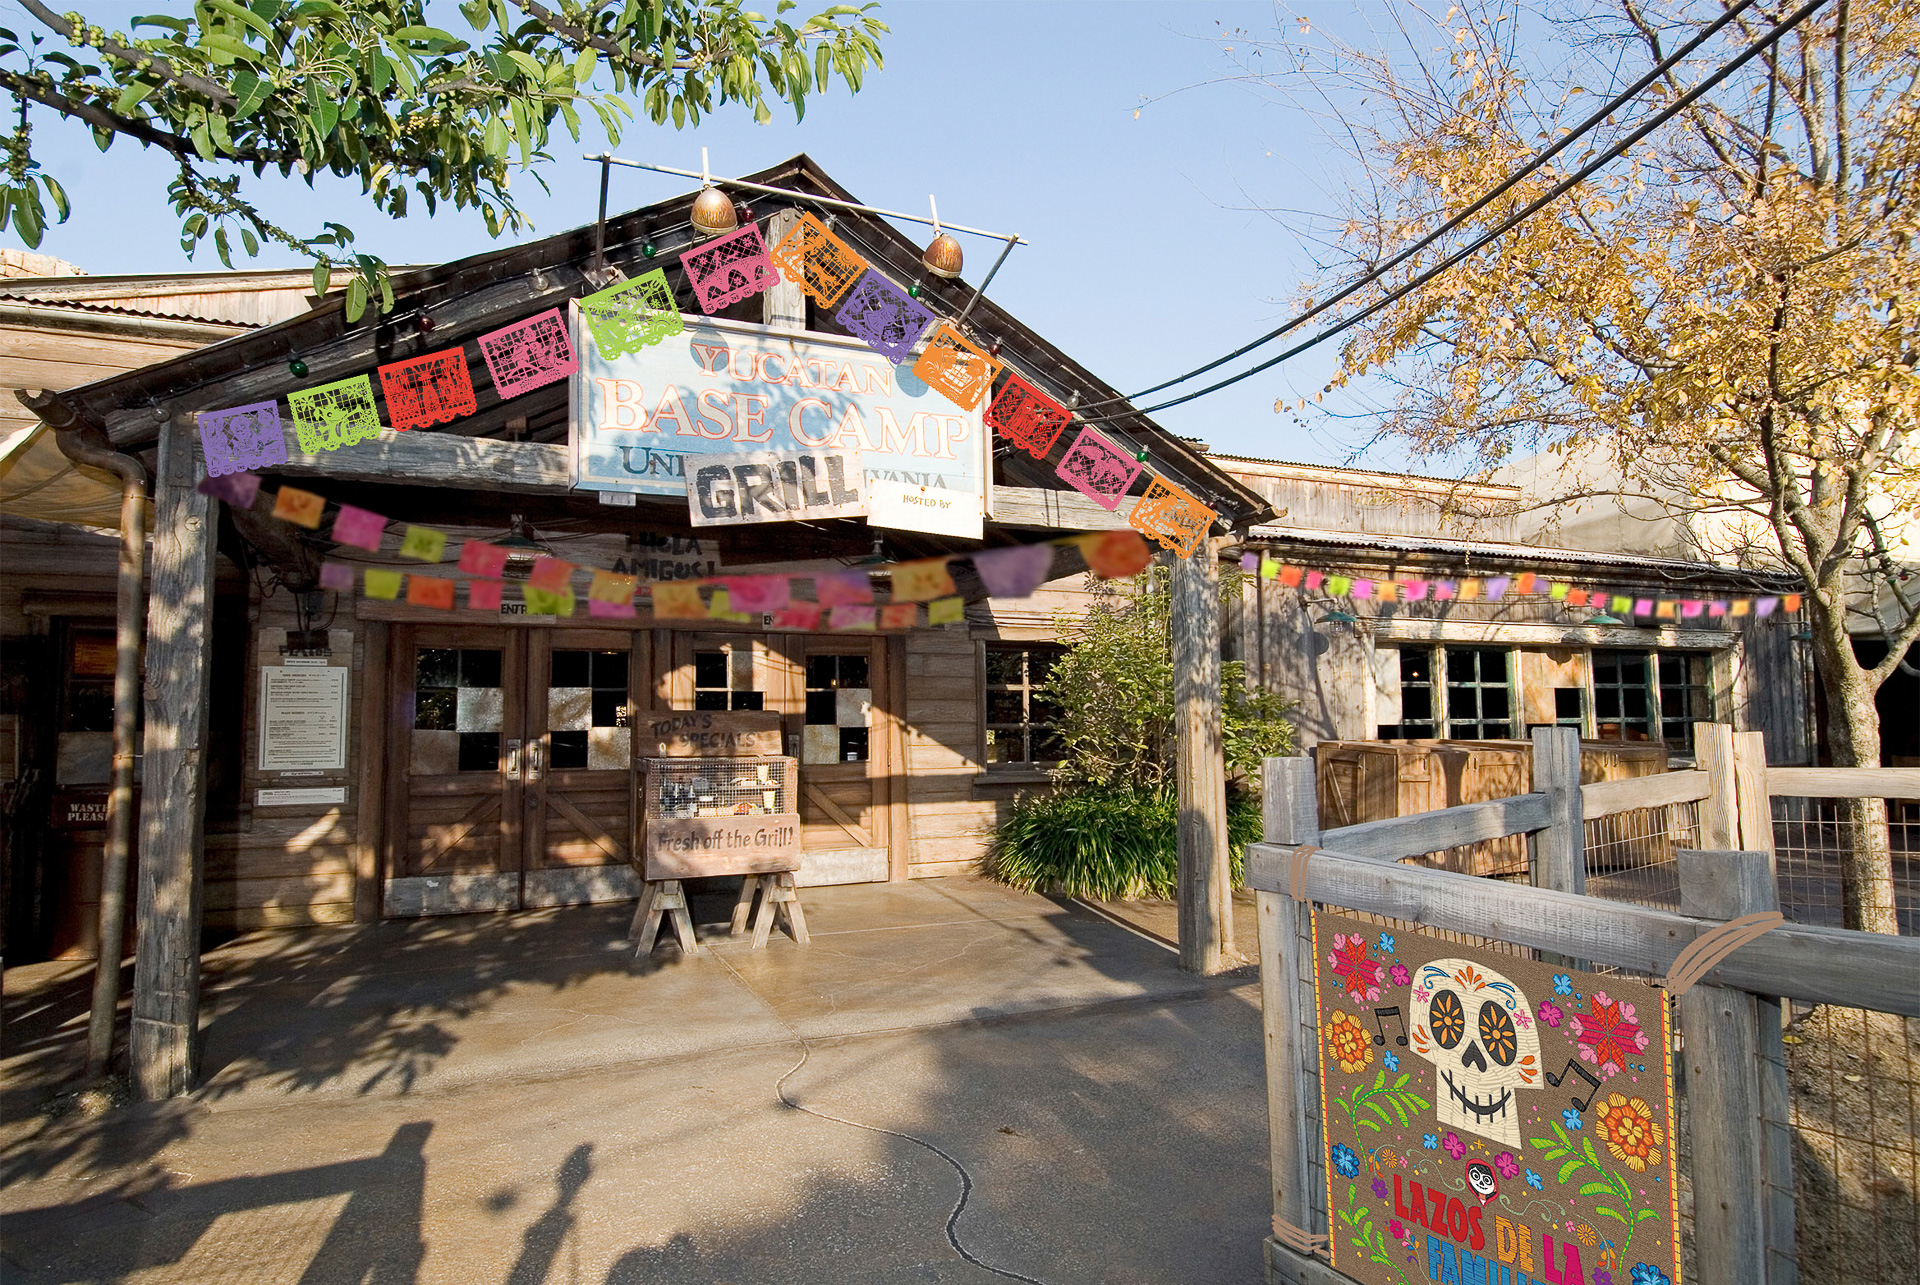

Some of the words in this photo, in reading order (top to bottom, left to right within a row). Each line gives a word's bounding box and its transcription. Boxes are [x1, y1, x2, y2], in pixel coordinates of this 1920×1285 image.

[691, 343, 894, 397] YUCATAN
[596, 377, 773, 443] BASE
[789, 398, 970, 459] CAMP
[696, 455, 859, 520] GRILL
[903, 494, 937, 508] HOSTED
[939, 500, 952, 509] BY
[651, 713, 712, 738] TODAY'S
[679, 732, 757, 748] SPECIALS
[658, 830, 699, 851] Fresh
[703, 829, 723, 850] off
[727, 829, 750, 848] the
[754, 826, 794, 848] Grill!
[1393, 1174, 1485, 1250] LAZOS
[1495, 1214, 1534, 1273] DE
[1542, 1233, 1585, 1285] LA
